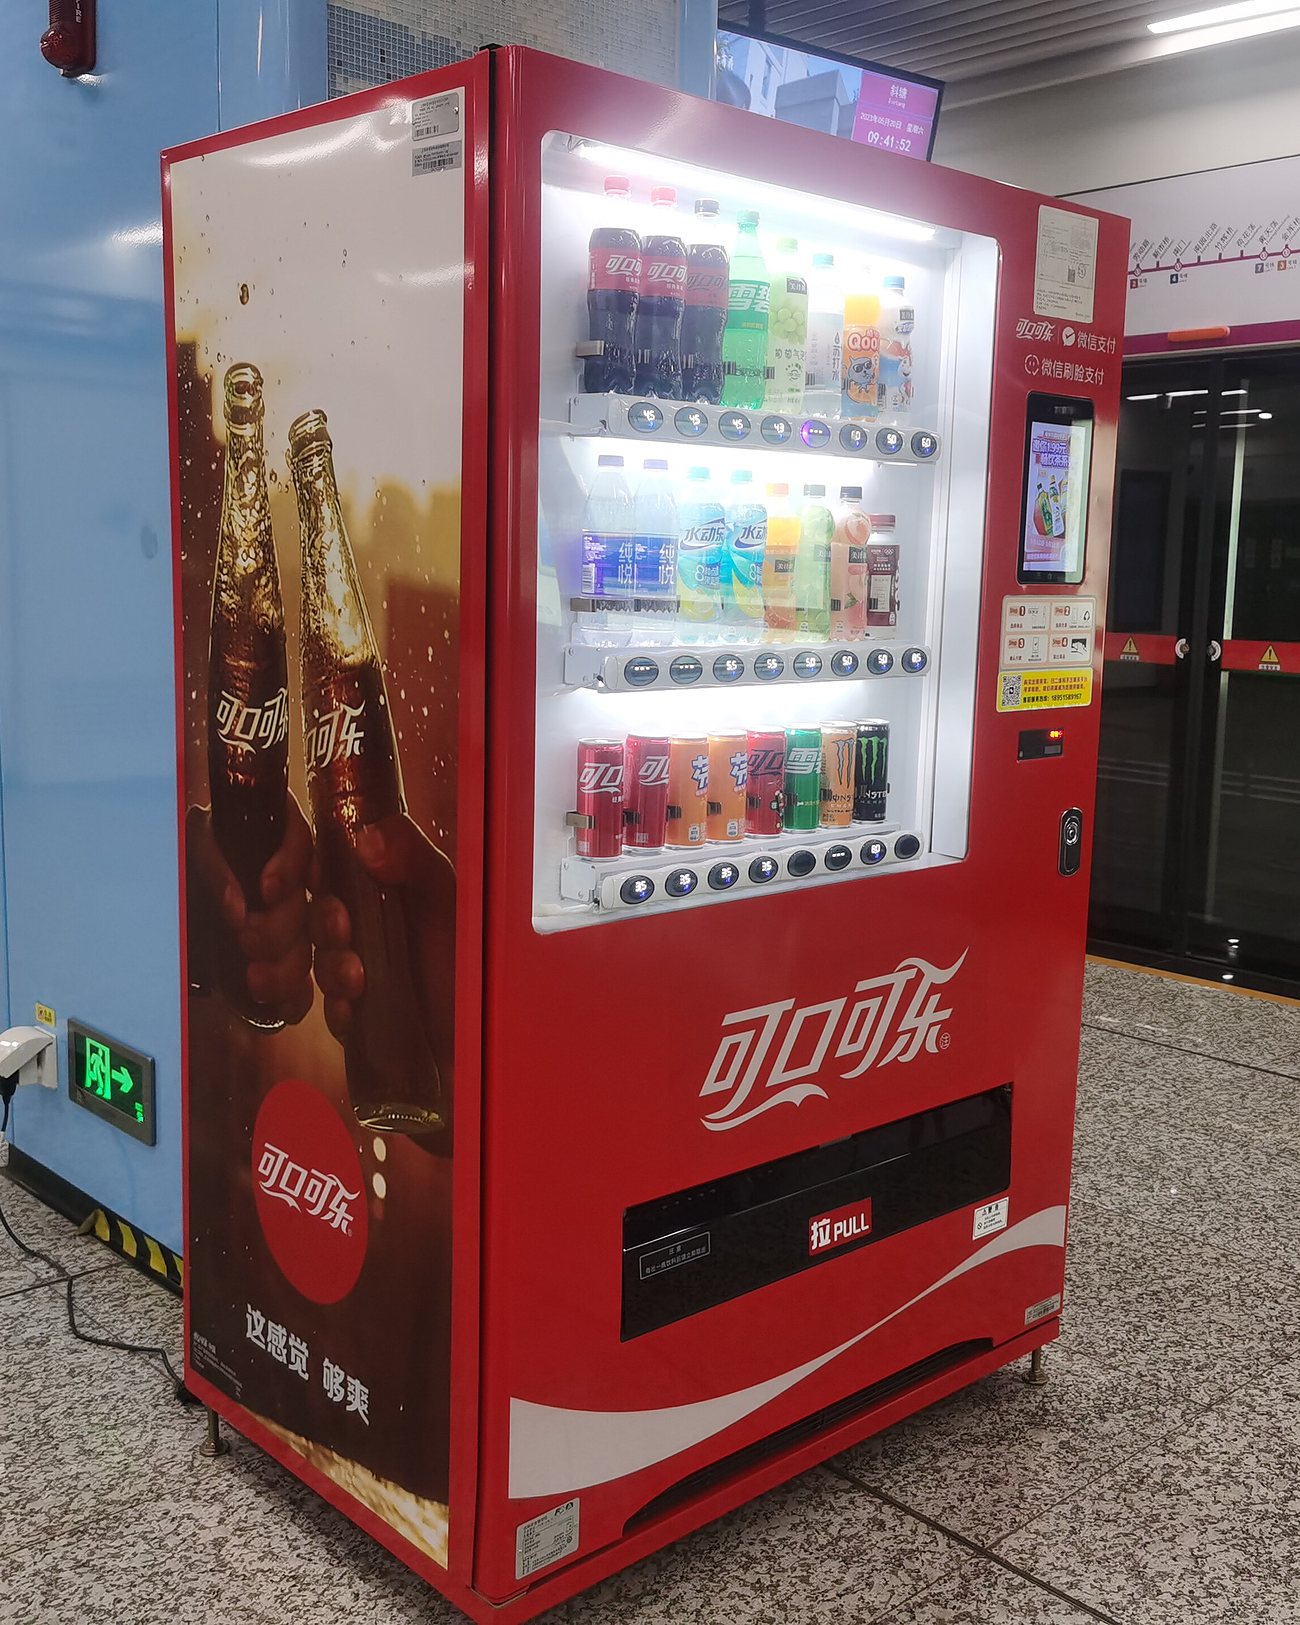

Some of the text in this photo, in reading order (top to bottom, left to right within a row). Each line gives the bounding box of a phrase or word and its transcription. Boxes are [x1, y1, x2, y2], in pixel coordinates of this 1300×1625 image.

[867, 130, 912, 152] 09:41:52
[1015, 318, 1056, 342] 可口可乐
[1077, 330, 1116, 355] 微信支付
[1041, 358, 1104, 385] 微信刷脸支付
[618, 541, 633, 585] 纯悦
[658, 543, 675, 585] 纯悦
[699, 946, 969, 1132] 可口可乐
[257, 1141, 361, 1235] 可口可乐
[811, 1213, 869, 1250] 拉 PULL
[245, 1303, 310, 1382] 这感觉
[322, 1356, 370, 1427] 够爽
